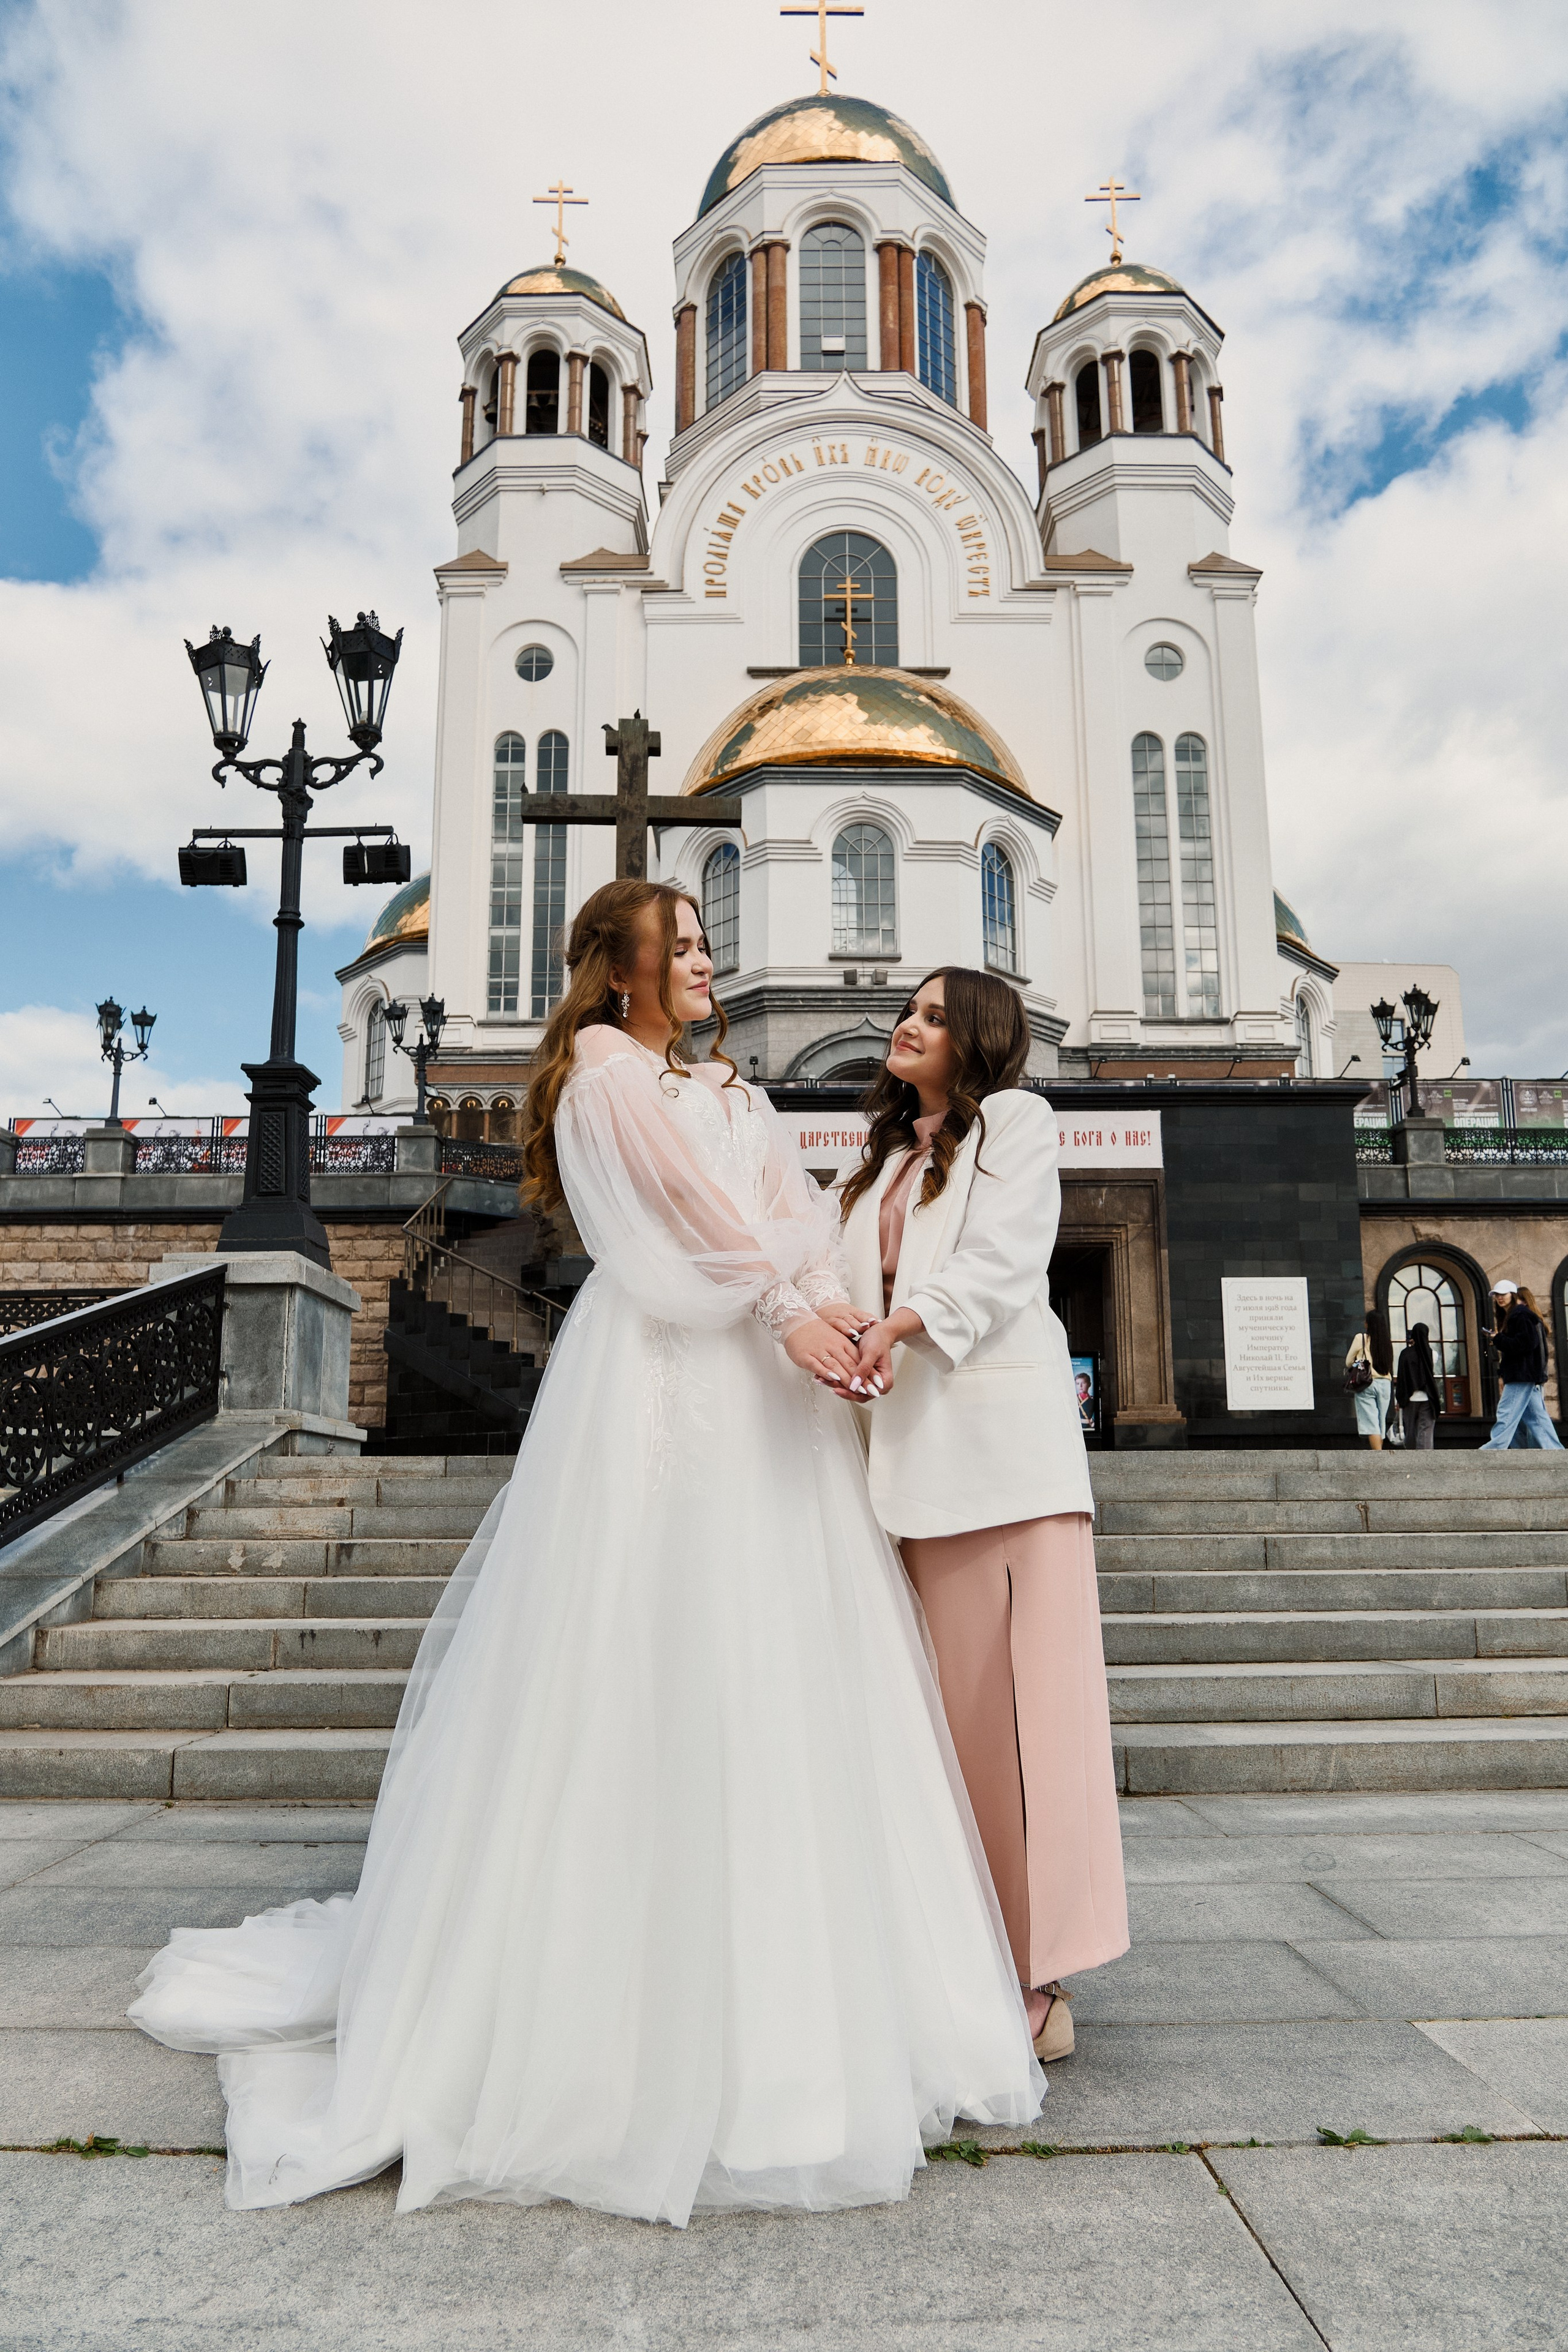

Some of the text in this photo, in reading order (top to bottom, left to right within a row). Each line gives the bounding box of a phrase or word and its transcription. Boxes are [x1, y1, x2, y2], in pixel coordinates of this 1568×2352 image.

[1354, 1117, 1387, 1128] ЕРАЦИЯ
[1453, 1117, 1499, 1128] ОПЕРАЦИЯ
[1074, 1131, 1102, 1146] БОГА
[1111, 1131, 1117, 1146] О
[1125, 1131, 1151, 1146] НАС!
[1247, 1344, 1289, 1352] Император
